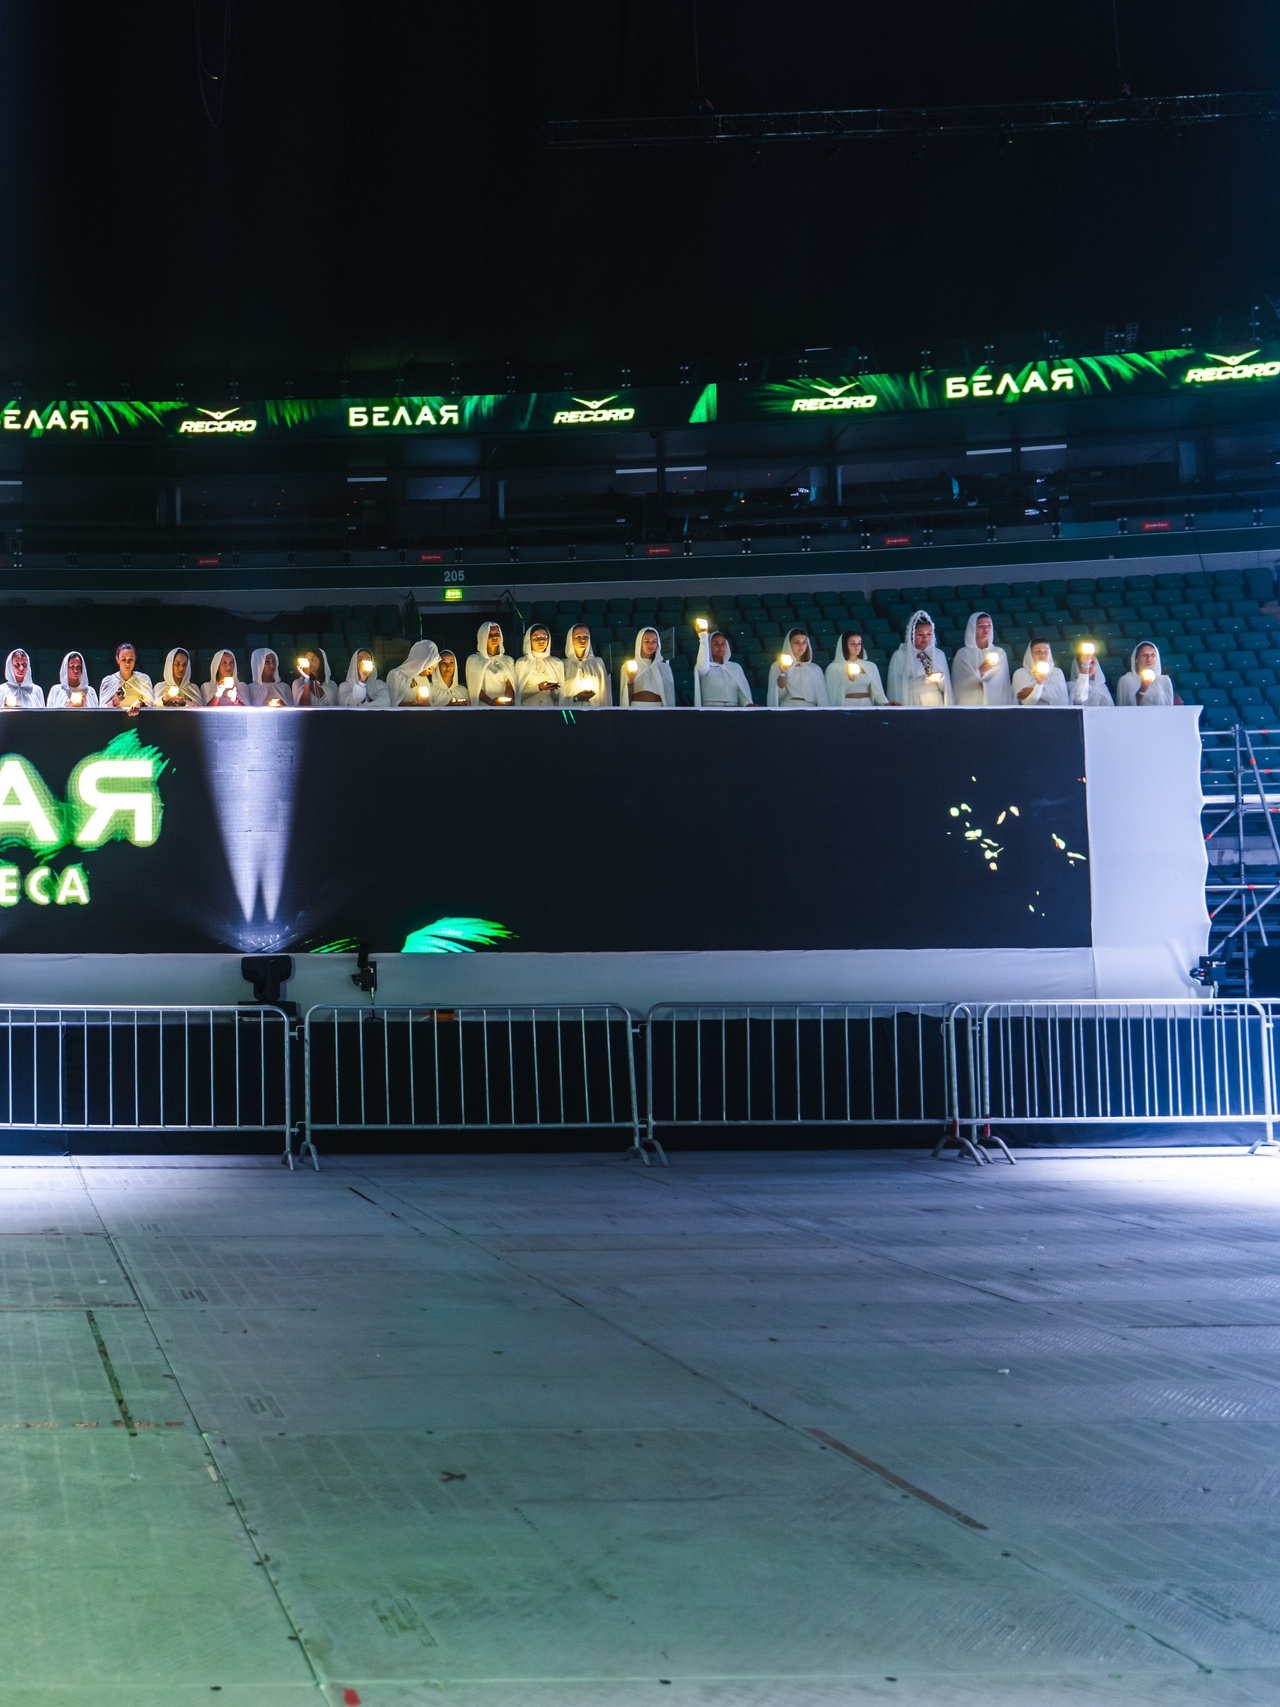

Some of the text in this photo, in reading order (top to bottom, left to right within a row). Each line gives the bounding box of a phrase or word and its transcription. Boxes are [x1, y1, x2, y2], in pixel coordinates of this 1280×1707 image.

[1184, 361, 1280, 384] RECORD
[946, 368, 1074, 399] БЕЛАЯ
[791, 395, 877, 412] RECORD
[348, 405, 459, 427] БЕЛАЯ
[553, 408, 635, 424] RECORD
[179, 419, 257, 433] RECORD
[443, 570, 465, 582] 205
